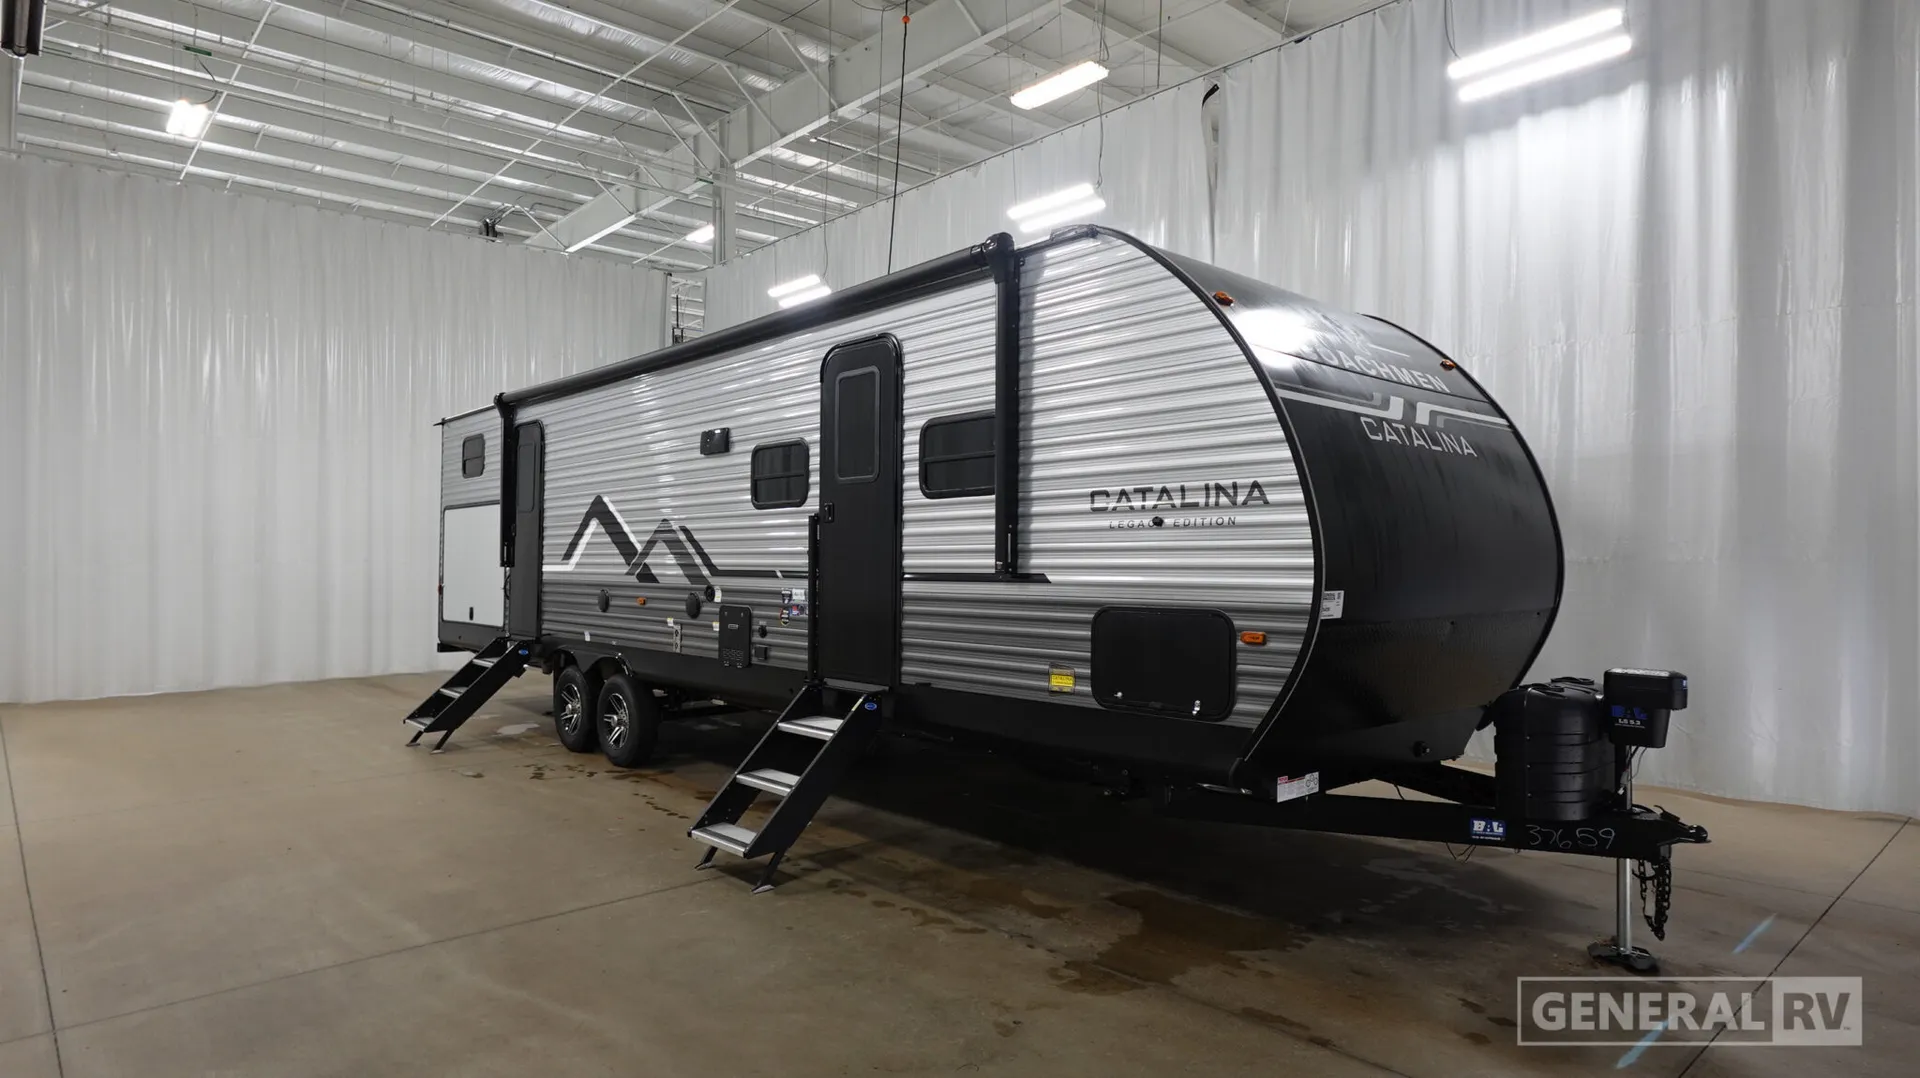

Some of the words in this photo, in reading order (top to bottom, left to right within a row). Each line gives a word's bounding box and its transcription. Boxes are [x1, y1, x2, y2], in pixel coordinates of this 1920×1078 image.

[1299, 337, 1451, 394] OACHMEN
[1359, 416, 1478, 458] CATALINA
[1089, 479, 1270, 512] CATALINA
[1108, 518, 1163, 530] LEGAC
[1173, 516, 1237, 528] EDITION
